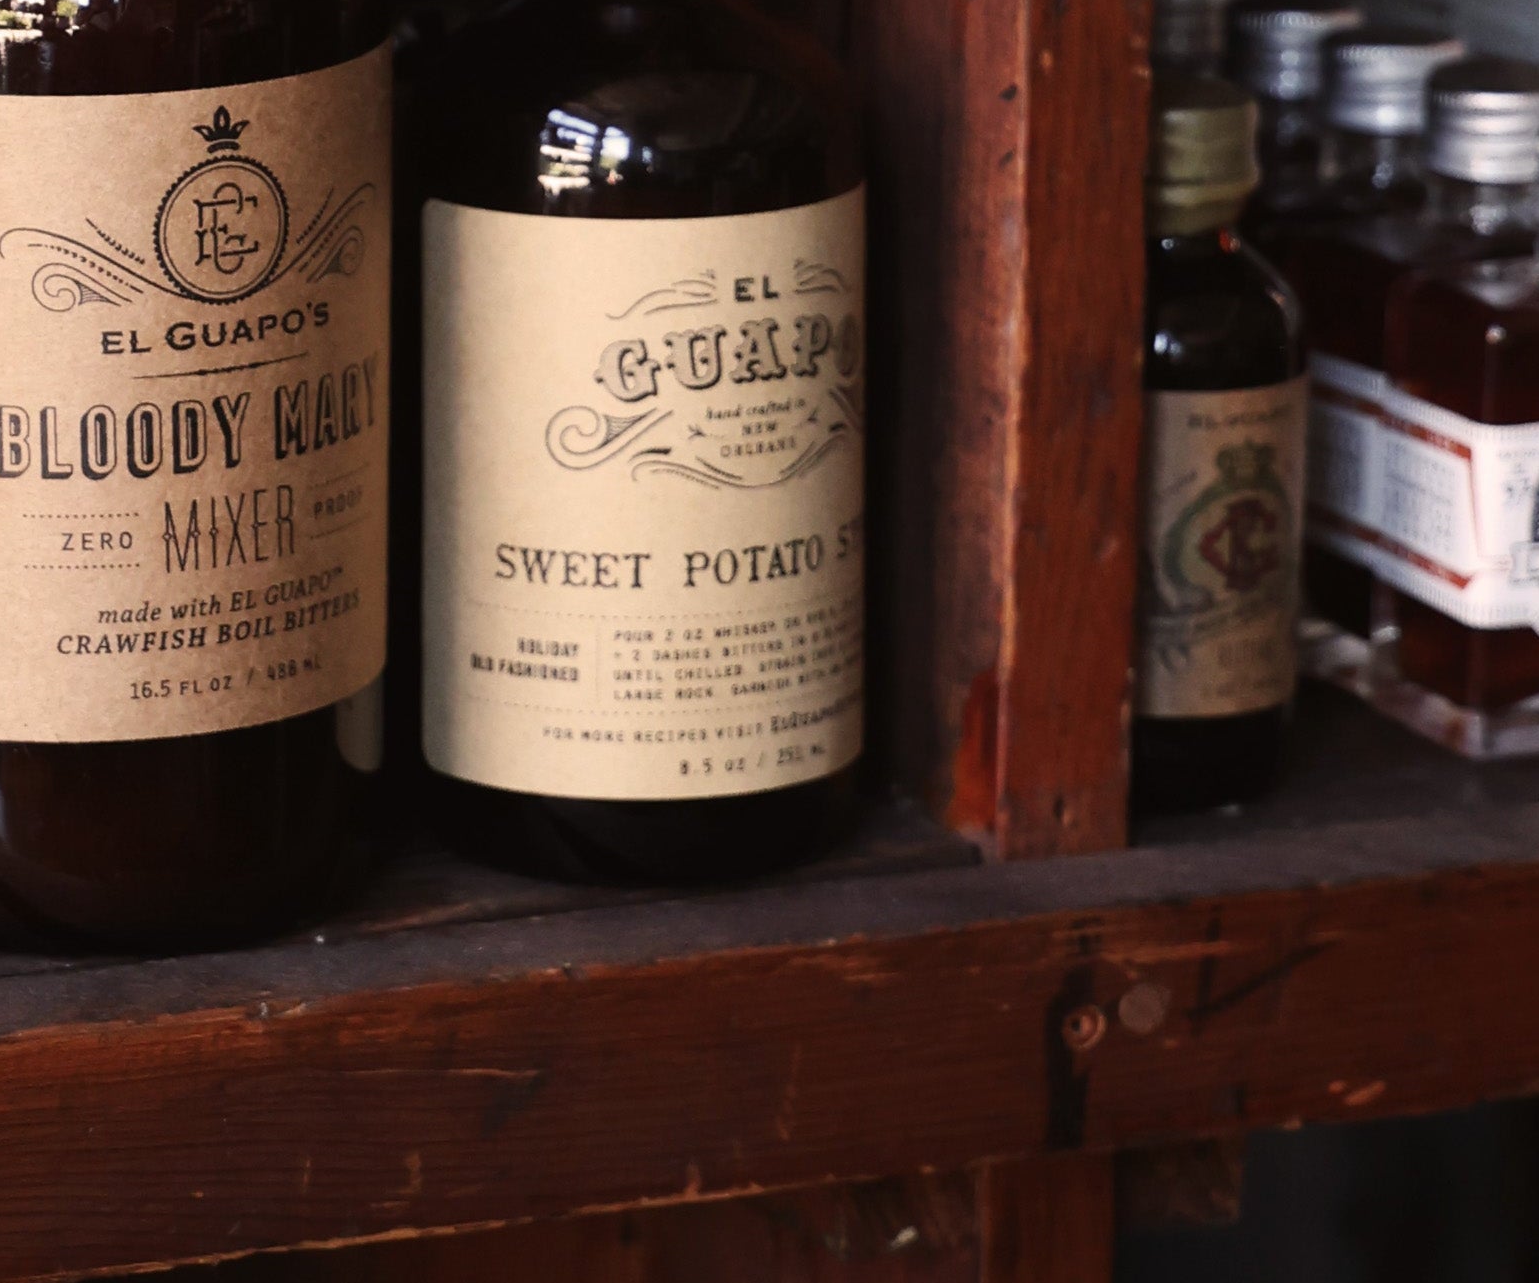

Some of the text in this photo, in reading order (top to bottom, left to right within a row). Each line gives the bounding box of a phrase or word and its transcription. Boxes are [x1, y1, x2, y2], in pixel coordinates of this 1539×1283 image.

[733, 275, 779, 303] EL
[101, 302, 330, 355] EL GUAPO'S
[274, 350, 378, 463] MARY
[62, 531, 133, 552] ZERO
[163, 484, 295, 574] MIXER
[495, 542, 651, 590] SWEET
[683, 533, 825, 589] POTATO
[57, 588, 361, 655] CRAWFISH BOIL BITTERS
[98, 601, 161, 624] made
[171, 595, 221, 620] with
[229, 592, 257, 612] EL
[130, 679, 171, 700] 16.5
[180, 677, 202, 696] FL
[210, 675, 233, 692] OZ
